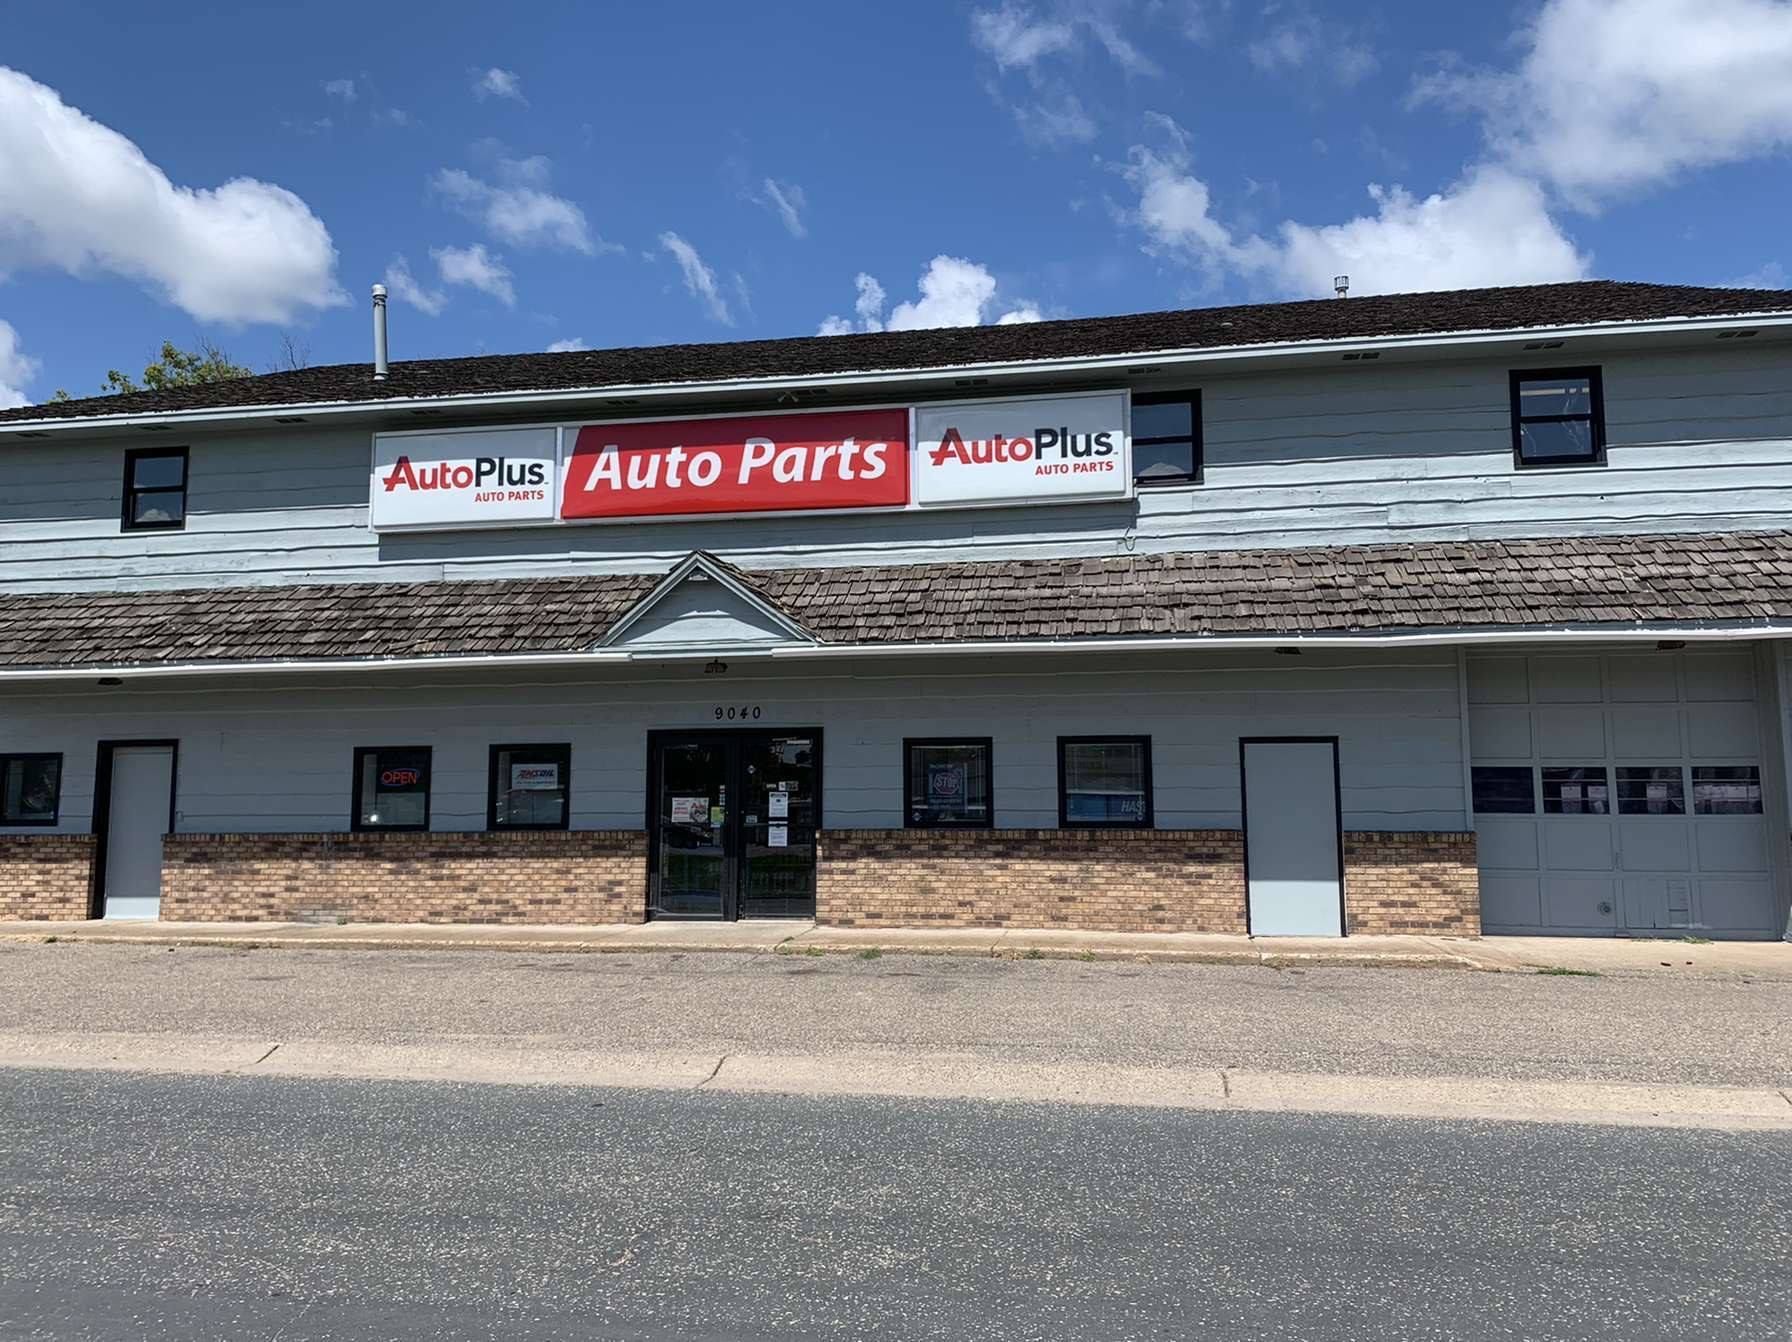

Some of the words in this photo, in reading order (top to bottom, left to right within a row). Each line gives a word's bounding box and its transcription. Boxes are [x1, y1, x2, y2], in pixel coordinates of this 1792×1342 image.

[929, 427, 1114, 466] AutoPlus
[584, 444, 722, 492] Auto
[737, 437, 888, 485] Parts
[1034, 463, 1069, 476] AUTO
[1072, 460, 1114, 473] PARTS
[382, 456, 545, 492] AutoPlus
[474, 491, 505, 503] AUTO
[508, 489, 545, 501] PARTS
[714, 706, 761, 720] 9040
[382, 771, 417, 785] OPEN
